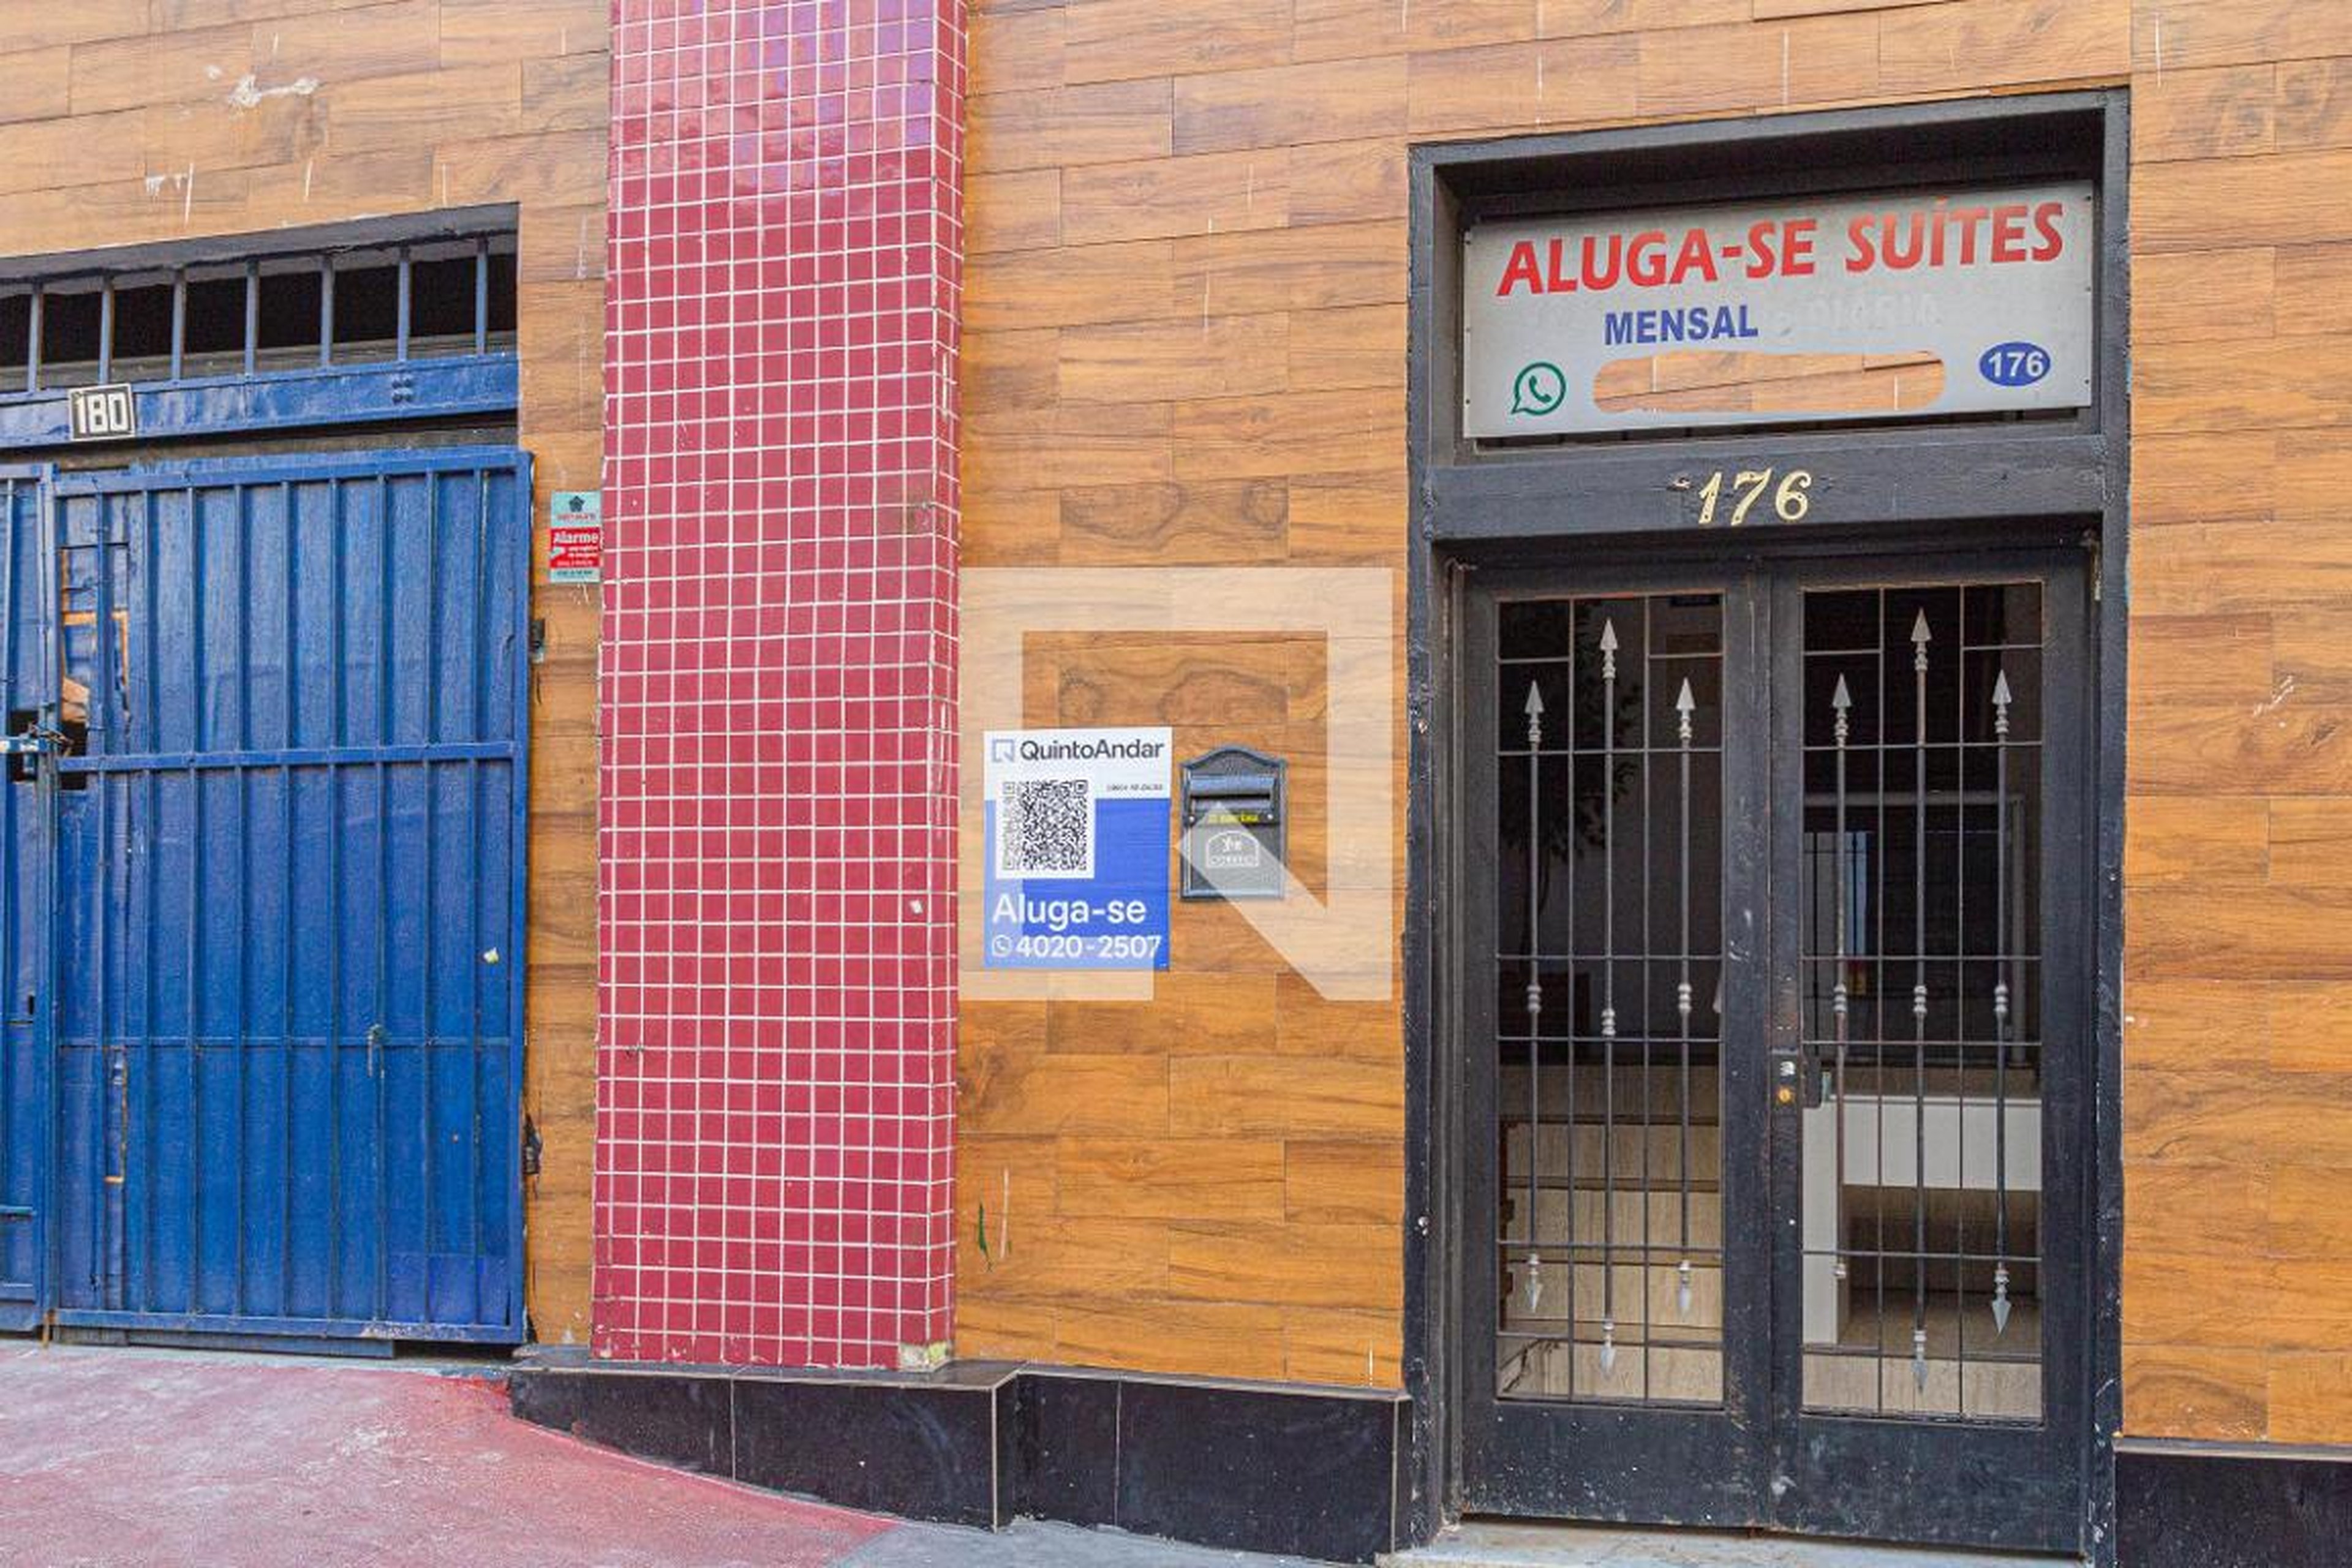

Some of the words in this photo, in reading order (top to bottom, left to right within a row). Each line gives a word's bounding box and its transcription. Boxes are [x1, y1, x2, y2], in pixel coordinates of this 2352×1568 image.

[1496, 218, 1817, 296] ALUGA-SE
[1845, 195, 2064, 273] SUÍTES
[1605, 304, 1759, 345] MENSAL
[1988, 351, 2044, 377] 176
[74, 393, 129, 434] 180
[1698, 467, 1812, 526] 176
[1020, 739, 1164, 761] QuintoAndar
[993, 892, 1147, 932] Aluga-se
[1016, 935, 1162, 959] 4020-2507
